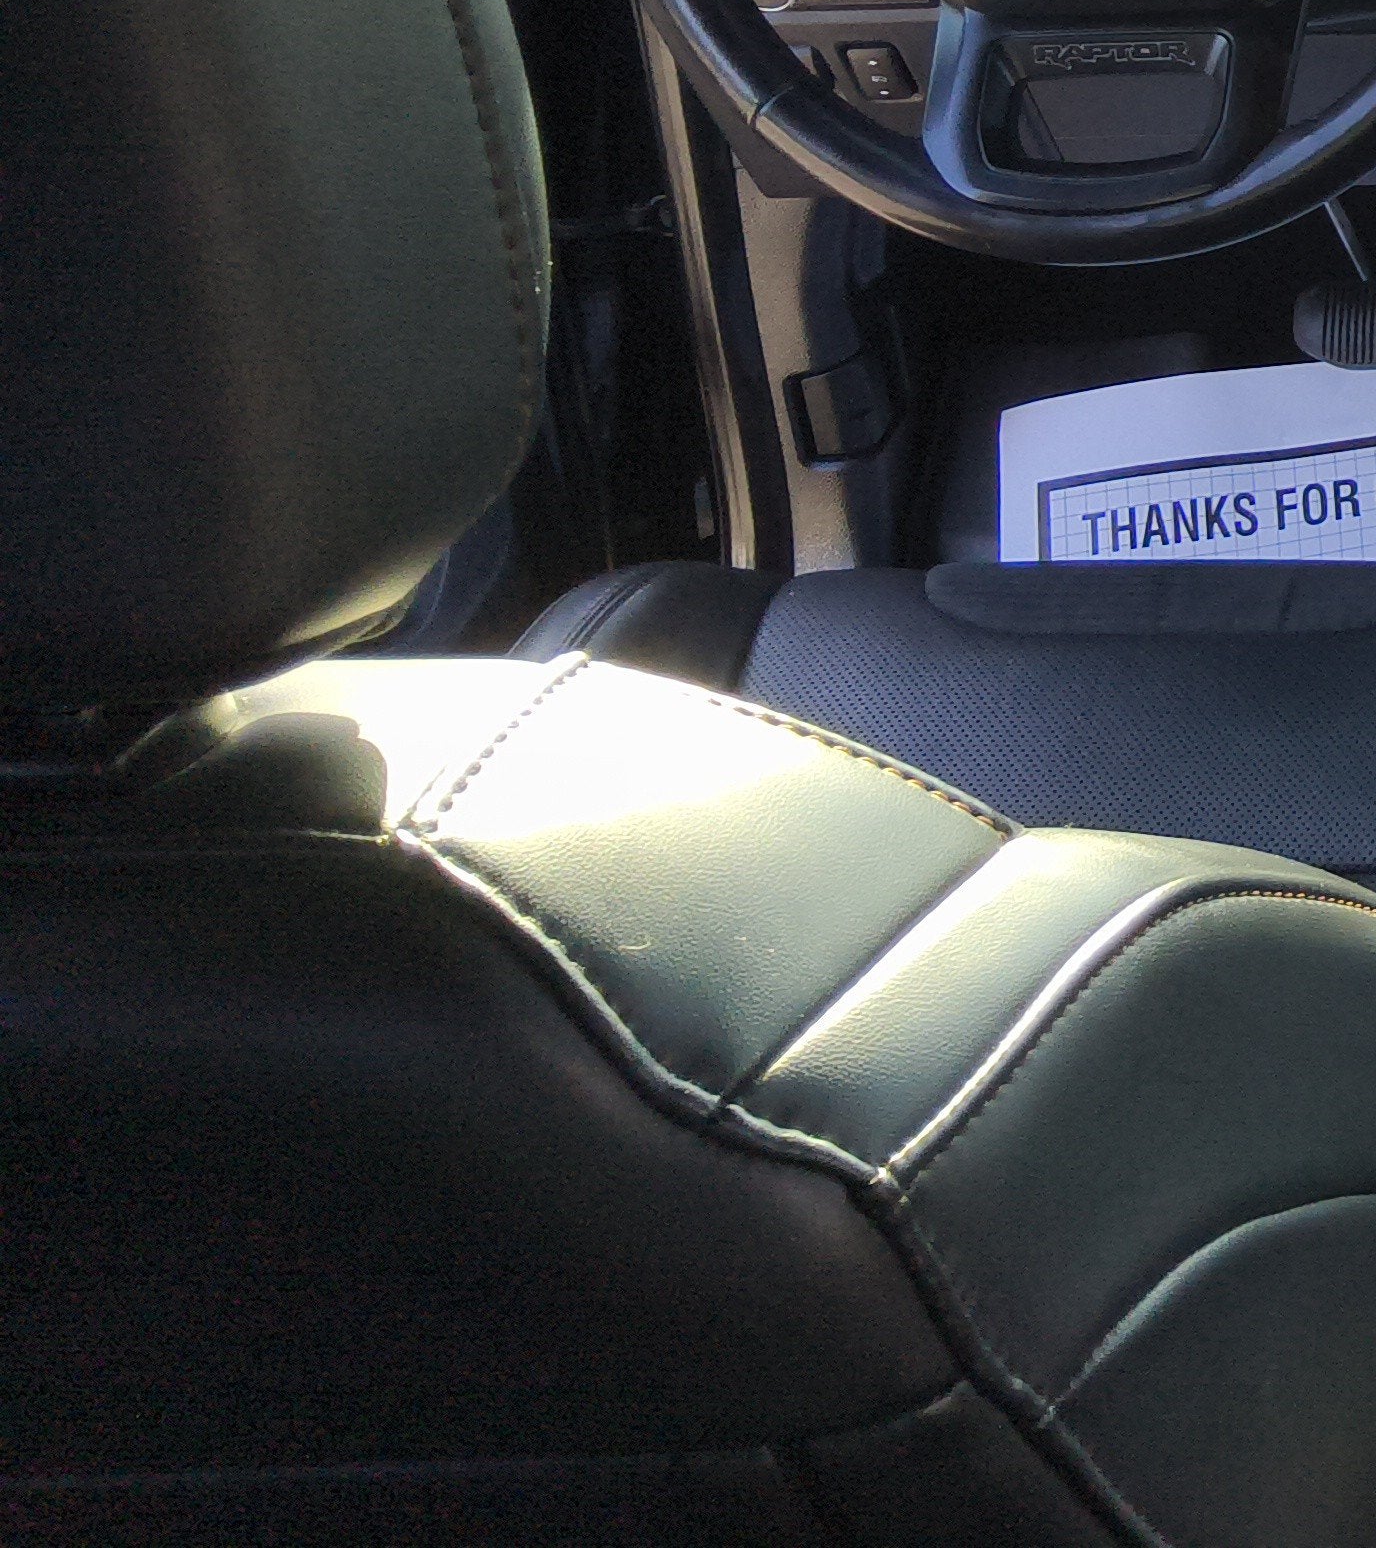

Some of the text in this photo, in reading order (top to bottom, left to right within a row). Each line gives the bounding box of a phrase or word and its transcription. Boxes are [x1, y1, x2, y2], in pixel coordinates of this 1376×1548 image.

[1033, 40, 1196, 70] RAPTOR
[1081, 491, 1259, 557] THANKS
[1275, 478, 1361, 530] FOR
